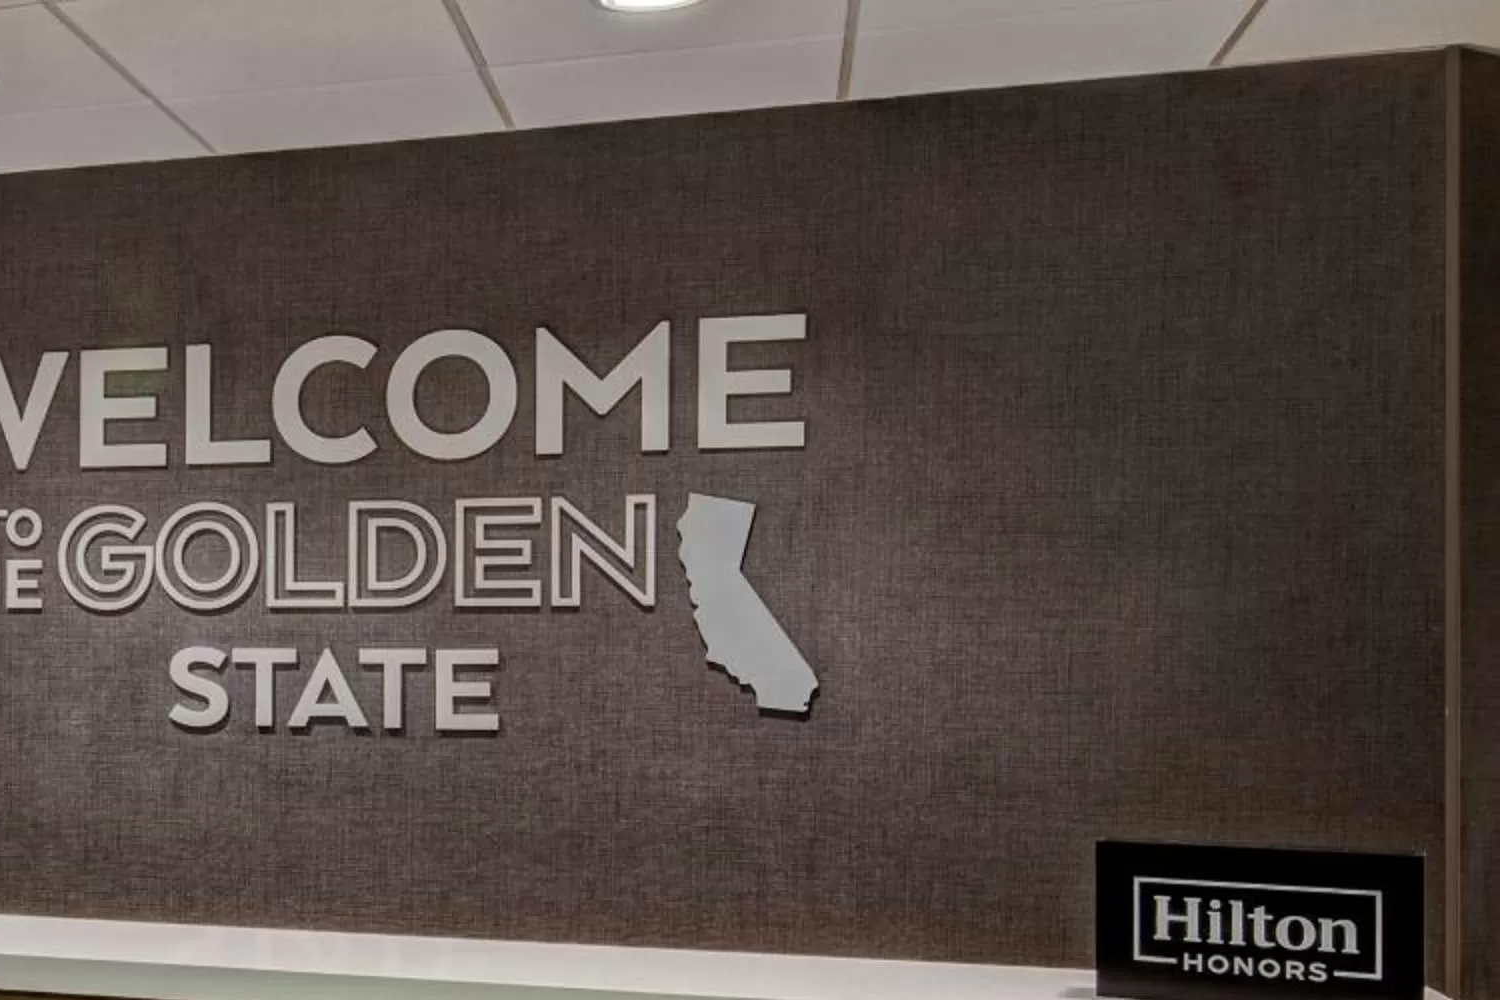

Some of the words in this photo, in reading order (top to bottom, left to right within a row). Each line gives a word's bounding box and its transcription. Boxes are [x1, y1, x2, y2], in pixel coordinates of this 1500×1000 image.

[57, 493, 657, 613] GOLDEN
[168, 645, 500, 732] STATE
[1153, 894, 1361, 955] Hilton
[1183, 951, 1330, 983] HONORS
